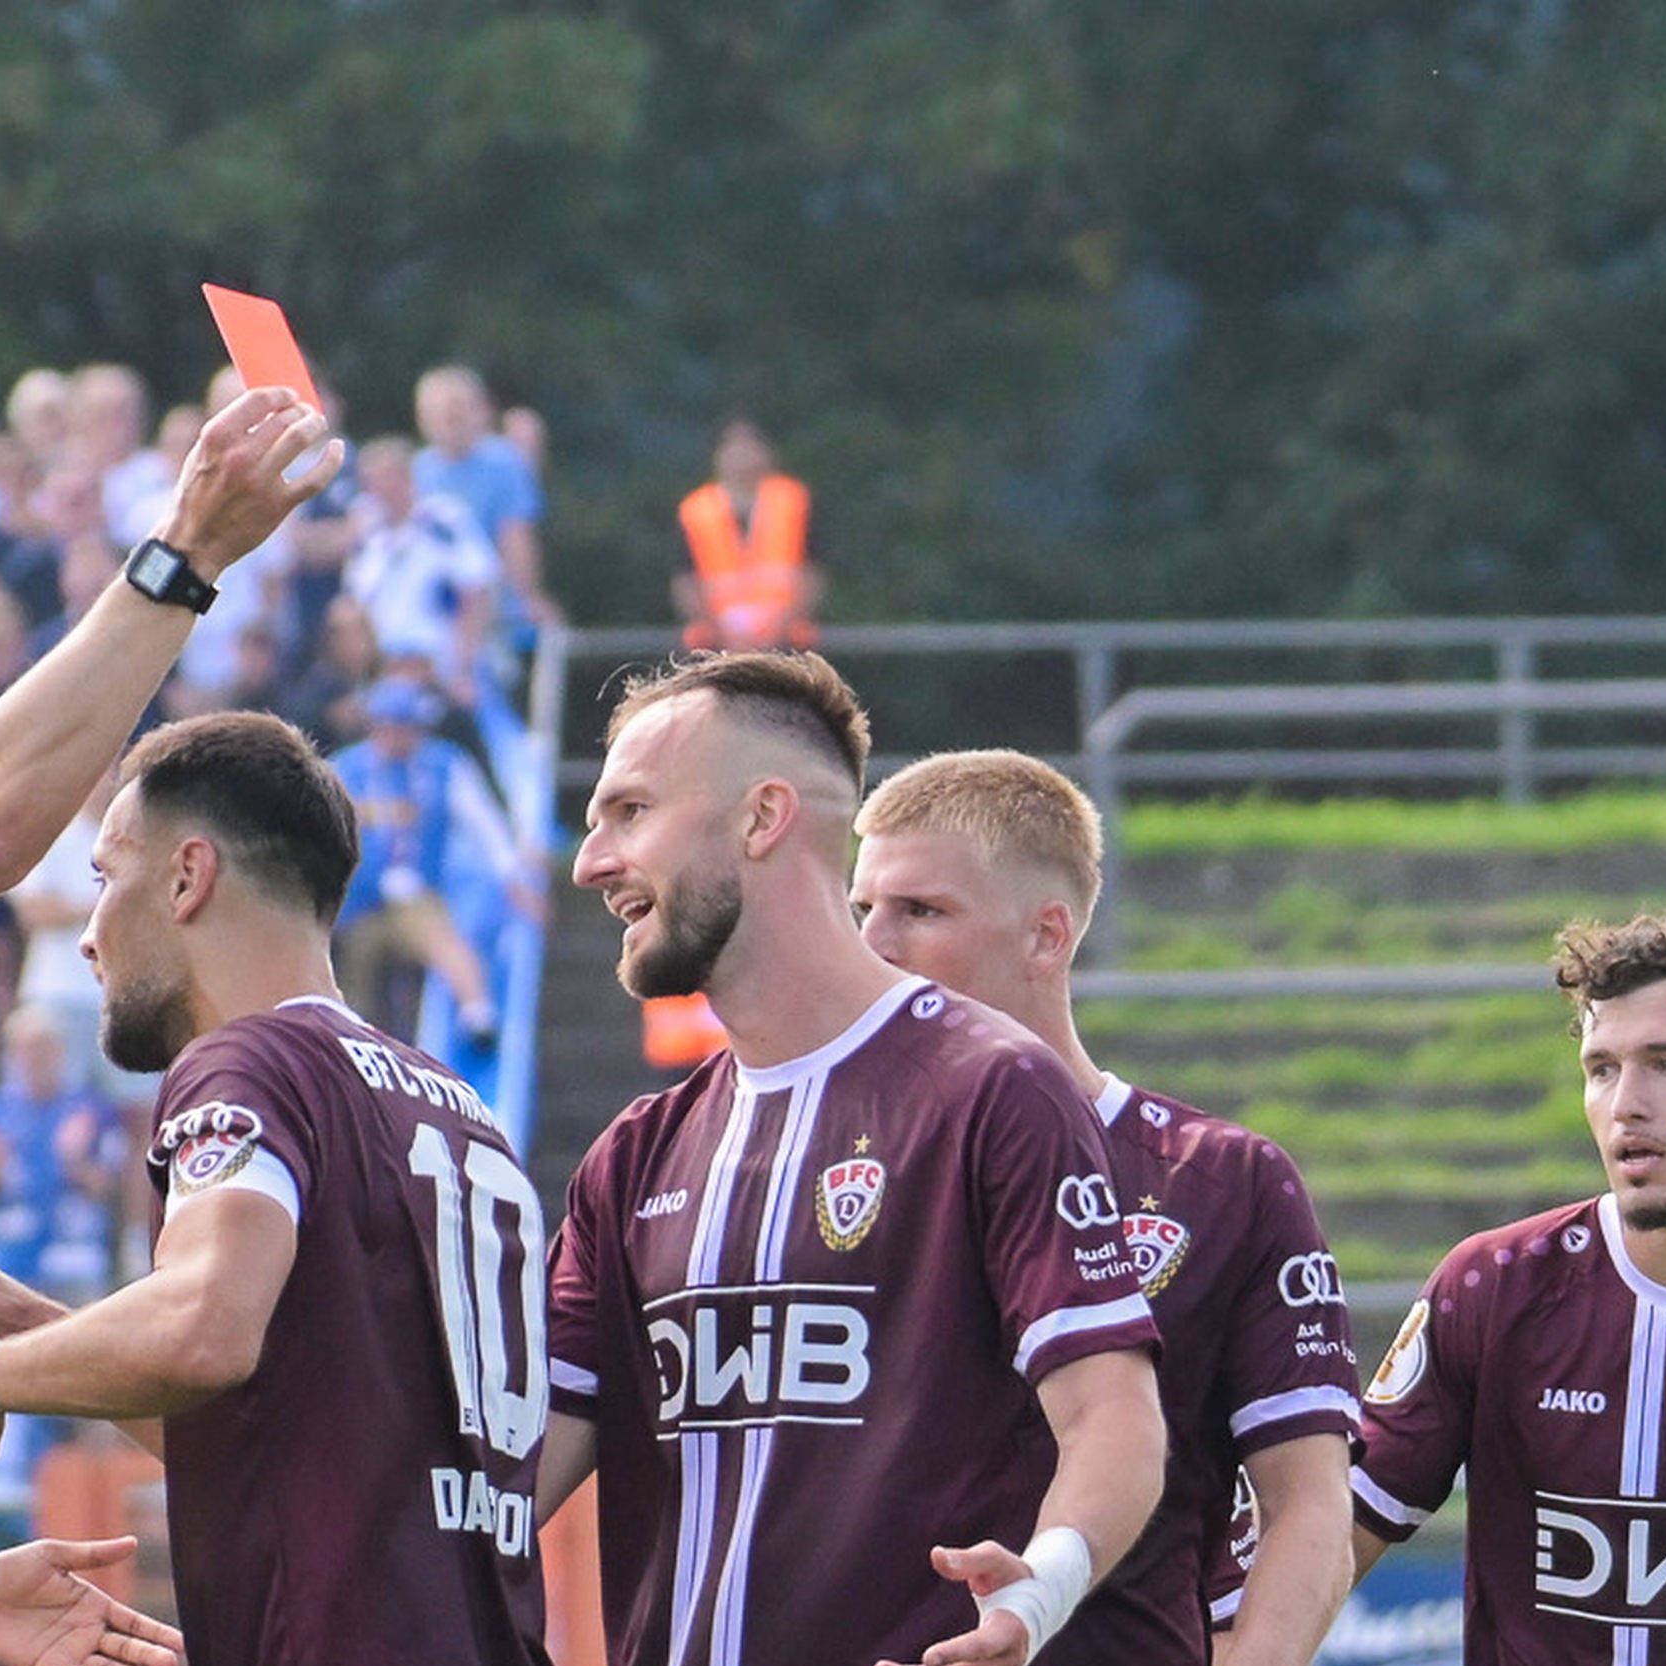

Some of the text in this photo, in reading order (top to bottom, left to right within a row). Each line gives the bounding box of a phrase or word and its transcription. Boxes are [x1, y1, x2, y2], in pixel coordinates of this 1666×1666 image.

[338, 1036, 420, 1098] BFC
[829, 1163, 880, 1190] BFC
[635, 1190, 688, 1220] JAKO
[408, 1122, 545, 1460] 10
[1539, 1388, 1606, 1414] JAKO
